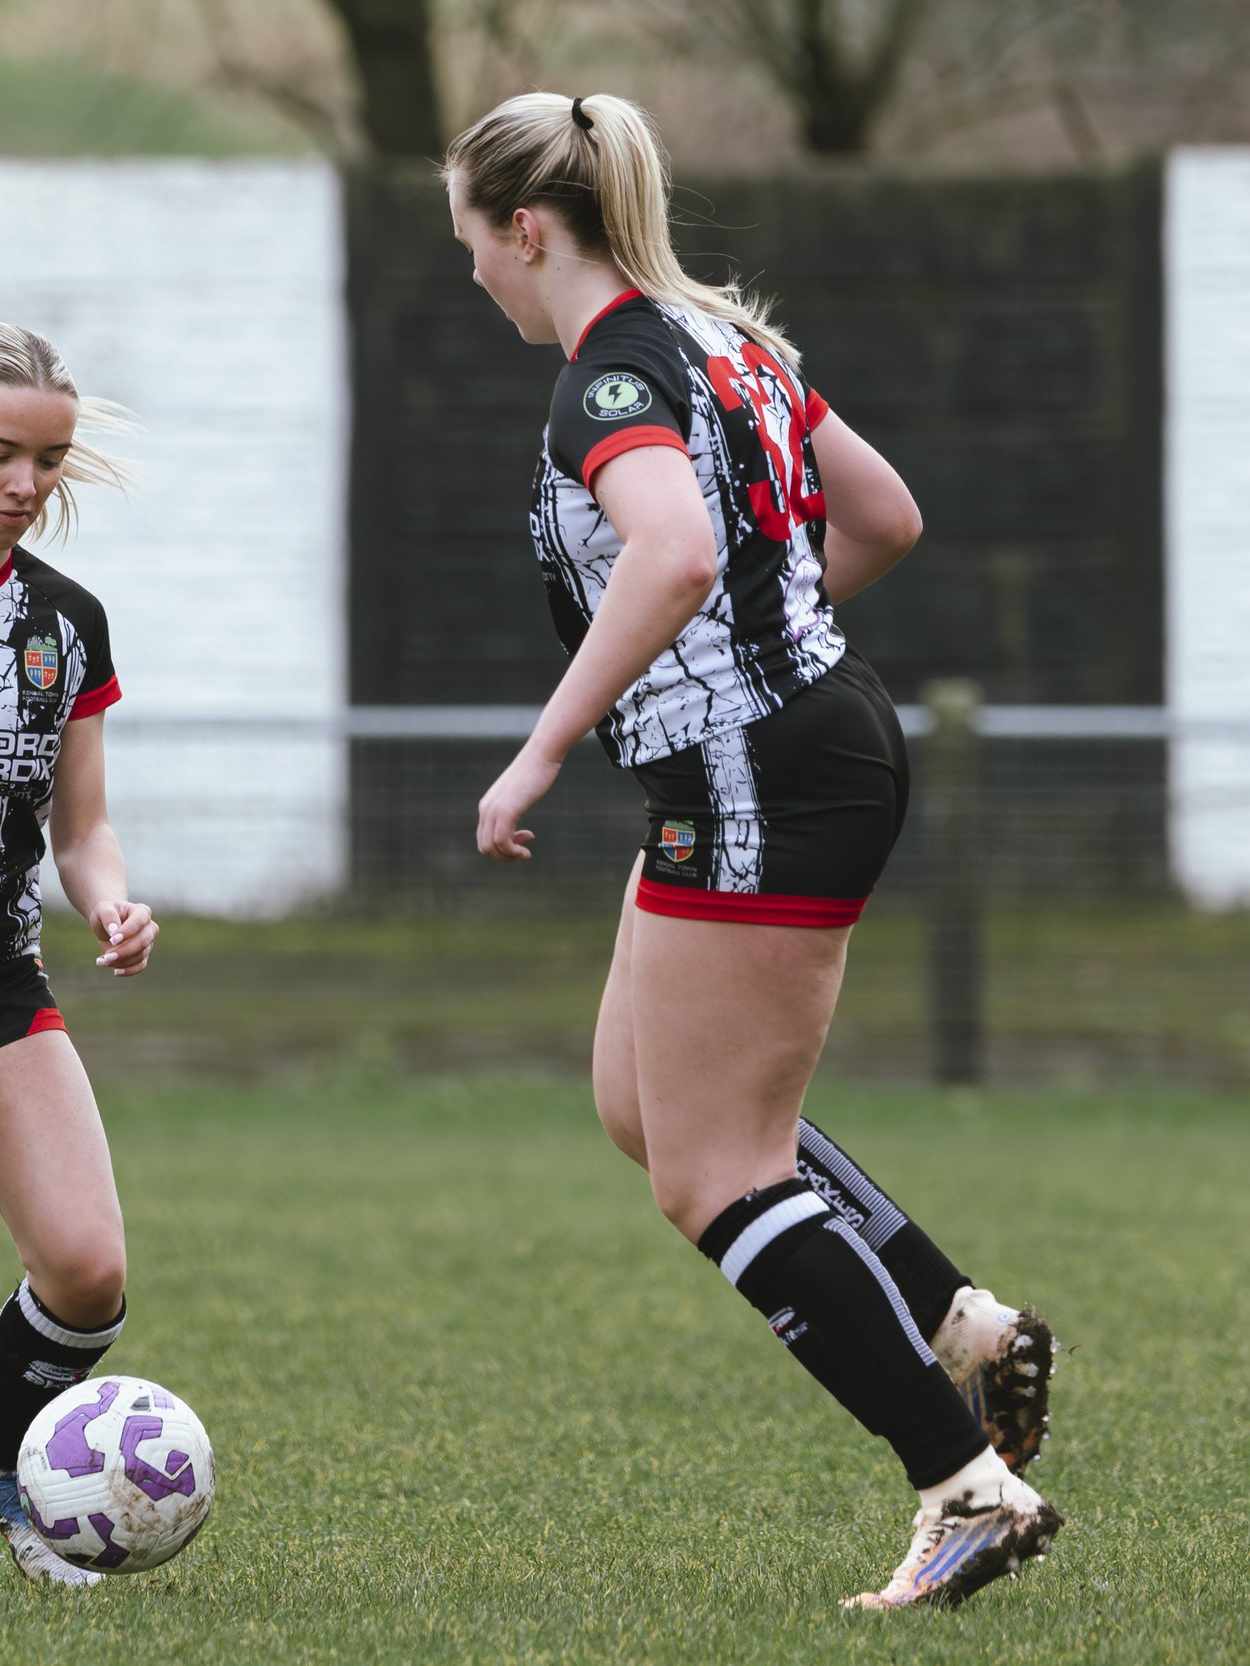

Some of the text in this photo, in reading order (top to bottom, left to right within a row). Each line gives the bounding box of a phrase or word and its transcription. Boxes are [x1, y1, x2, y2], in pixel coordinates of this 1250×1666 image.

[588, 375, 645, 398] INFINITUS
[599, 401, 645, 417] SOLAR
[707, 342, 827, 541] 32
